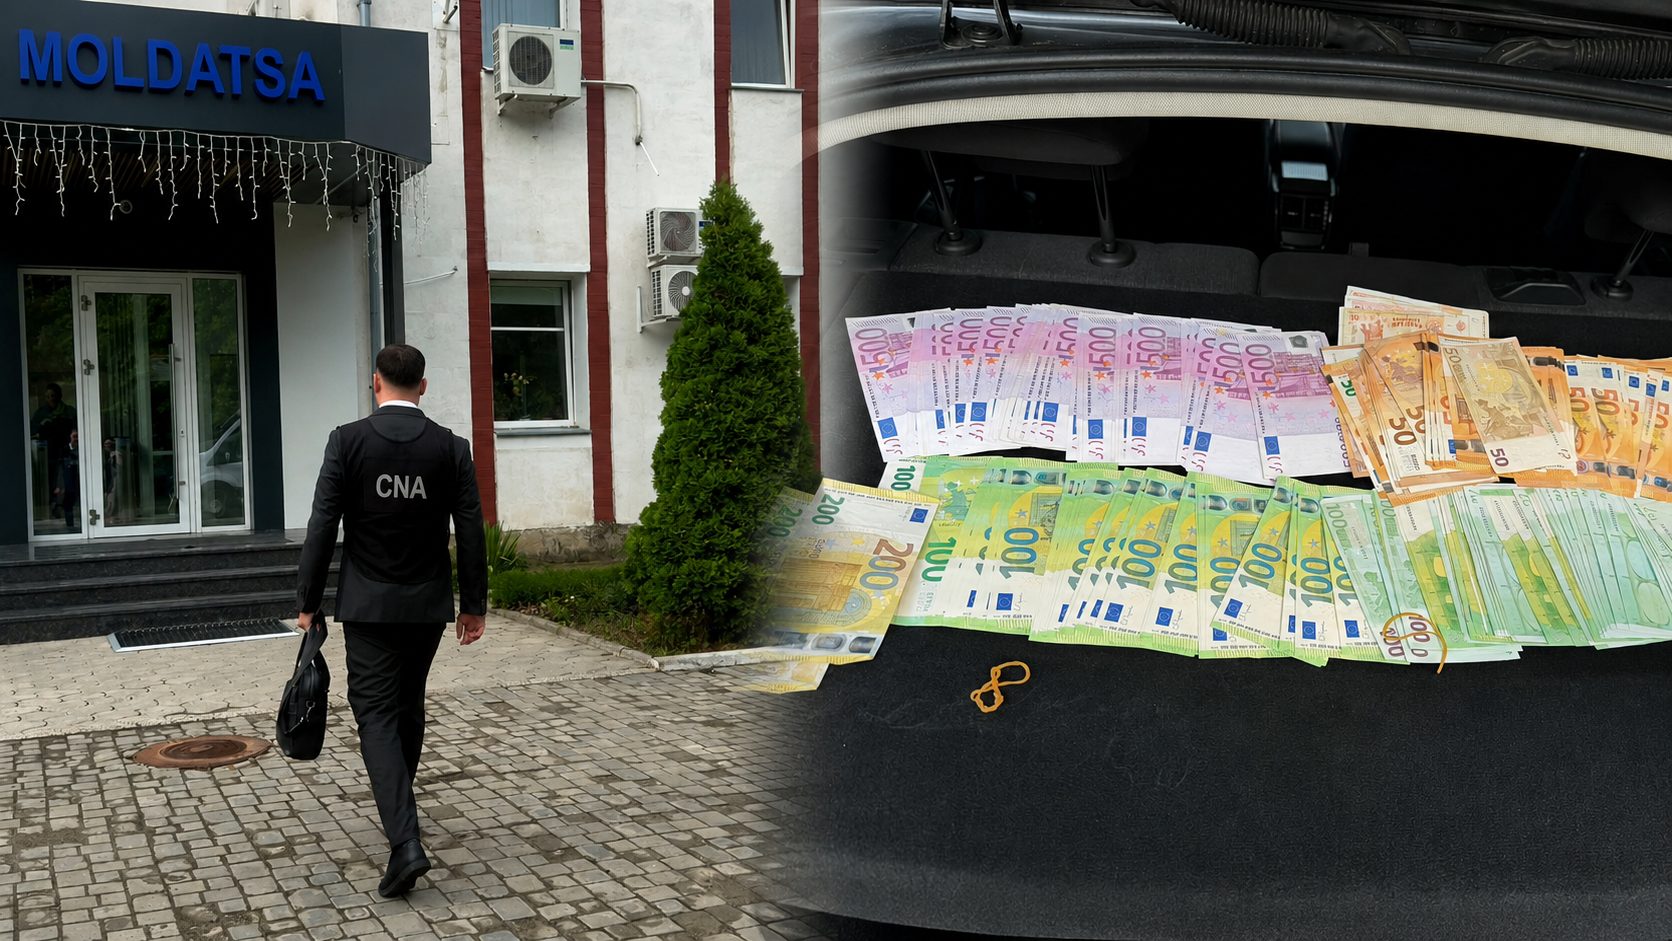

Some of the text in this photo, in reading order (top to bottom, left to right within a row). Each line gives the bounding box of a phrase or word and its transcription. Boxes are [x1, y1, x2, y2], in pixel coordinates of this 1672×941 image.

[18, 29, 326, 101] MOLDATSA
[855, 328, 894, 366] 500
[1088, 327, 1117, 364] 500
[1138, 326, 1166, 363] 500
[1245, 344, 1279, 384] 500
[1591, 388, 1620, 416] 50
[1490, 448, 1509, 467] 50
[376, 473, 427, 499] CNA
[890, 465, 916, 491] 100
[767, 504, 802, 537] 200
[812, 494, 845, 525] 200
[859, 538, 914, 590] 200
[1000, 527, 1039, 579] 100
[1116, 539, 1162, 590] 100
[1238, 543, 1283, 590] 100
[1300, 557, 1333, 608] 100
